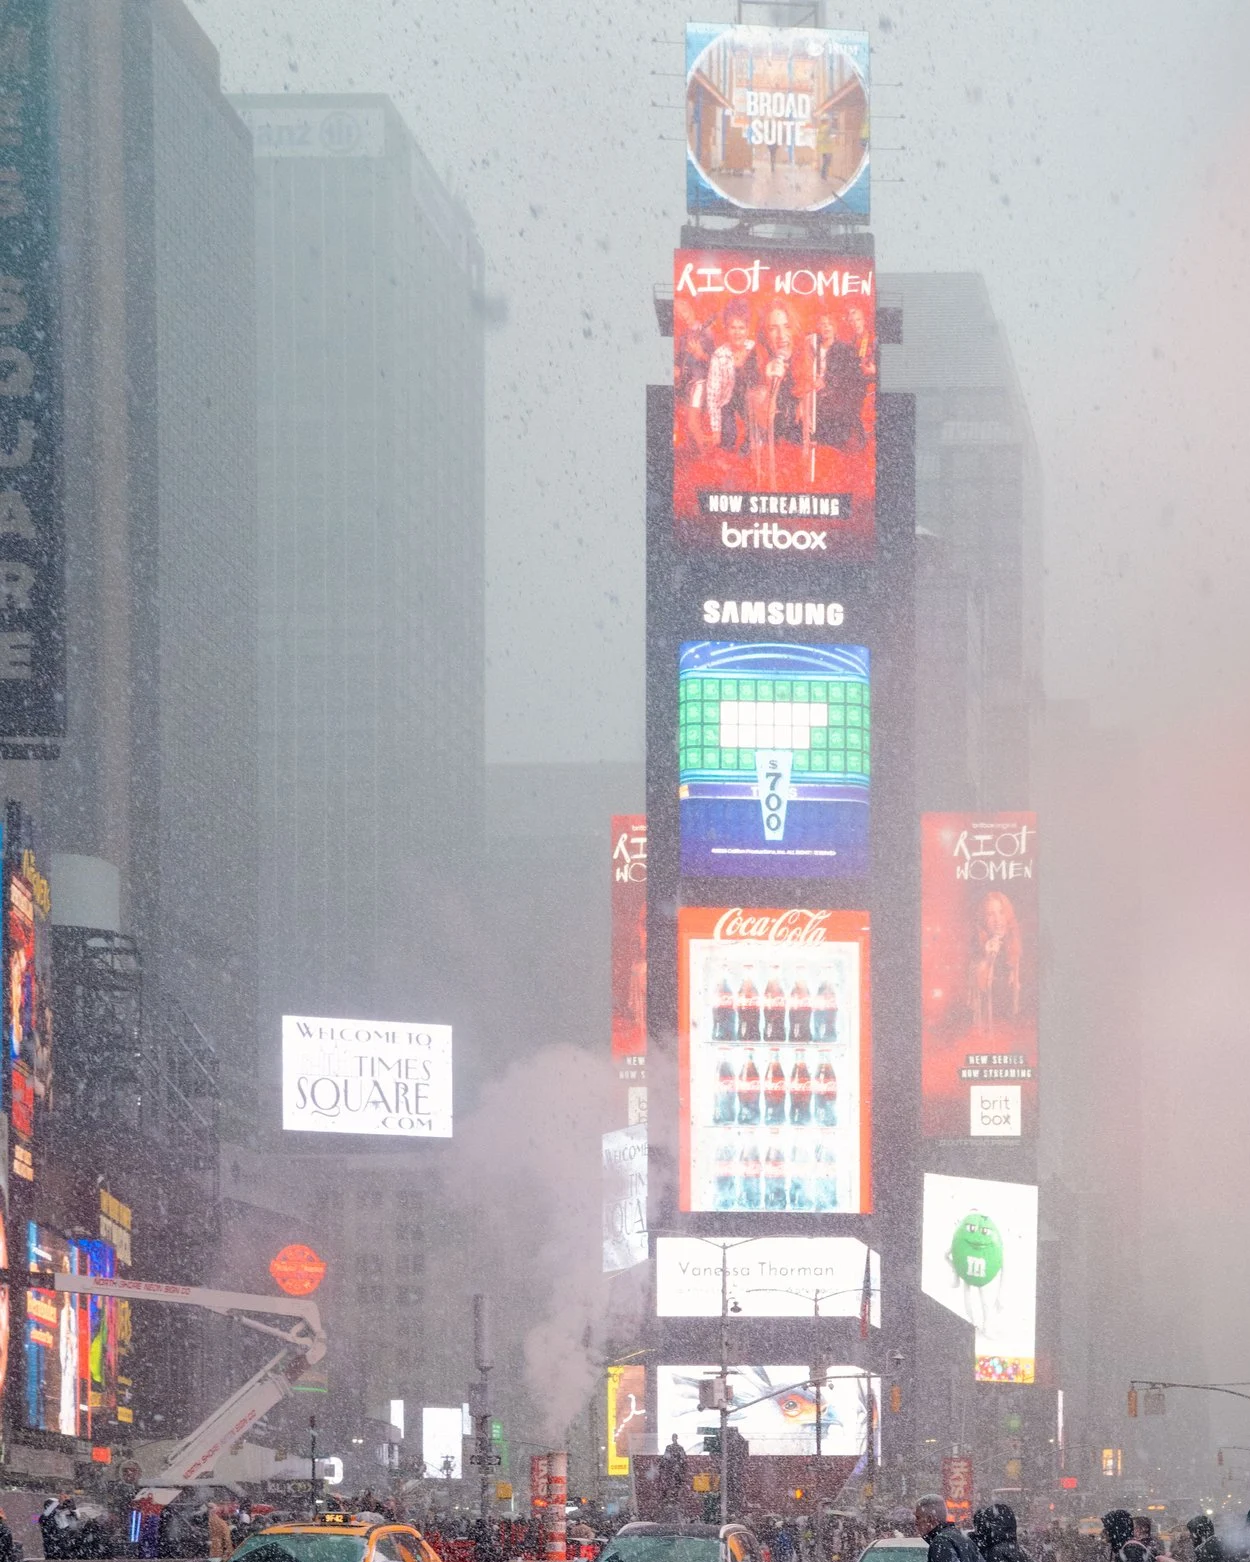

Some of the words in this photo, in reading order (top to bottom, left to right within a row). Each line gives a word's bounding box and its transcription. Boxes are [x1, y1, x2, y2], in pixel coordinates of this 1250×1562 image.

[745, 90, 812, 120] BROAD
[751, 119, 806, 146] SUITE
[677, 260, 770, 296] RIOT
[774, 269, 872, 296] WOMEN
[709, 495, 743, 513] NOW
[750, 496, 840, 516] STREAMING
[721, 522, 827, 550] britbox
[703, 600, 845, 626] SAMSUNG
[953, 825, 1036, 861] RIOT
[956, 859, 1033, 881] WOMEN
[713, 908, 832, 946] Coca-Cola
[296, 1021, 395, 1044] WELCOME
[407, 1032, 432, 1046] TO
[354, 1056, 432, 1081] TIMES
[968, 1055, 988, 1064] NEW
[992, 1055, 1024, 1064] SERIES
[961, 1069, 979, 1078] NOW
[983, 1069, 1032, 1078] STREAMING
[296, 1076, 432, 1117] SQUARE
[980, 1096, 1010, 1110] brit
[980, 1111, 1011, 1126] box
[678, 1262, 750, 1277] Vanessa
[758, 1261, 834, 1277] Thorman
